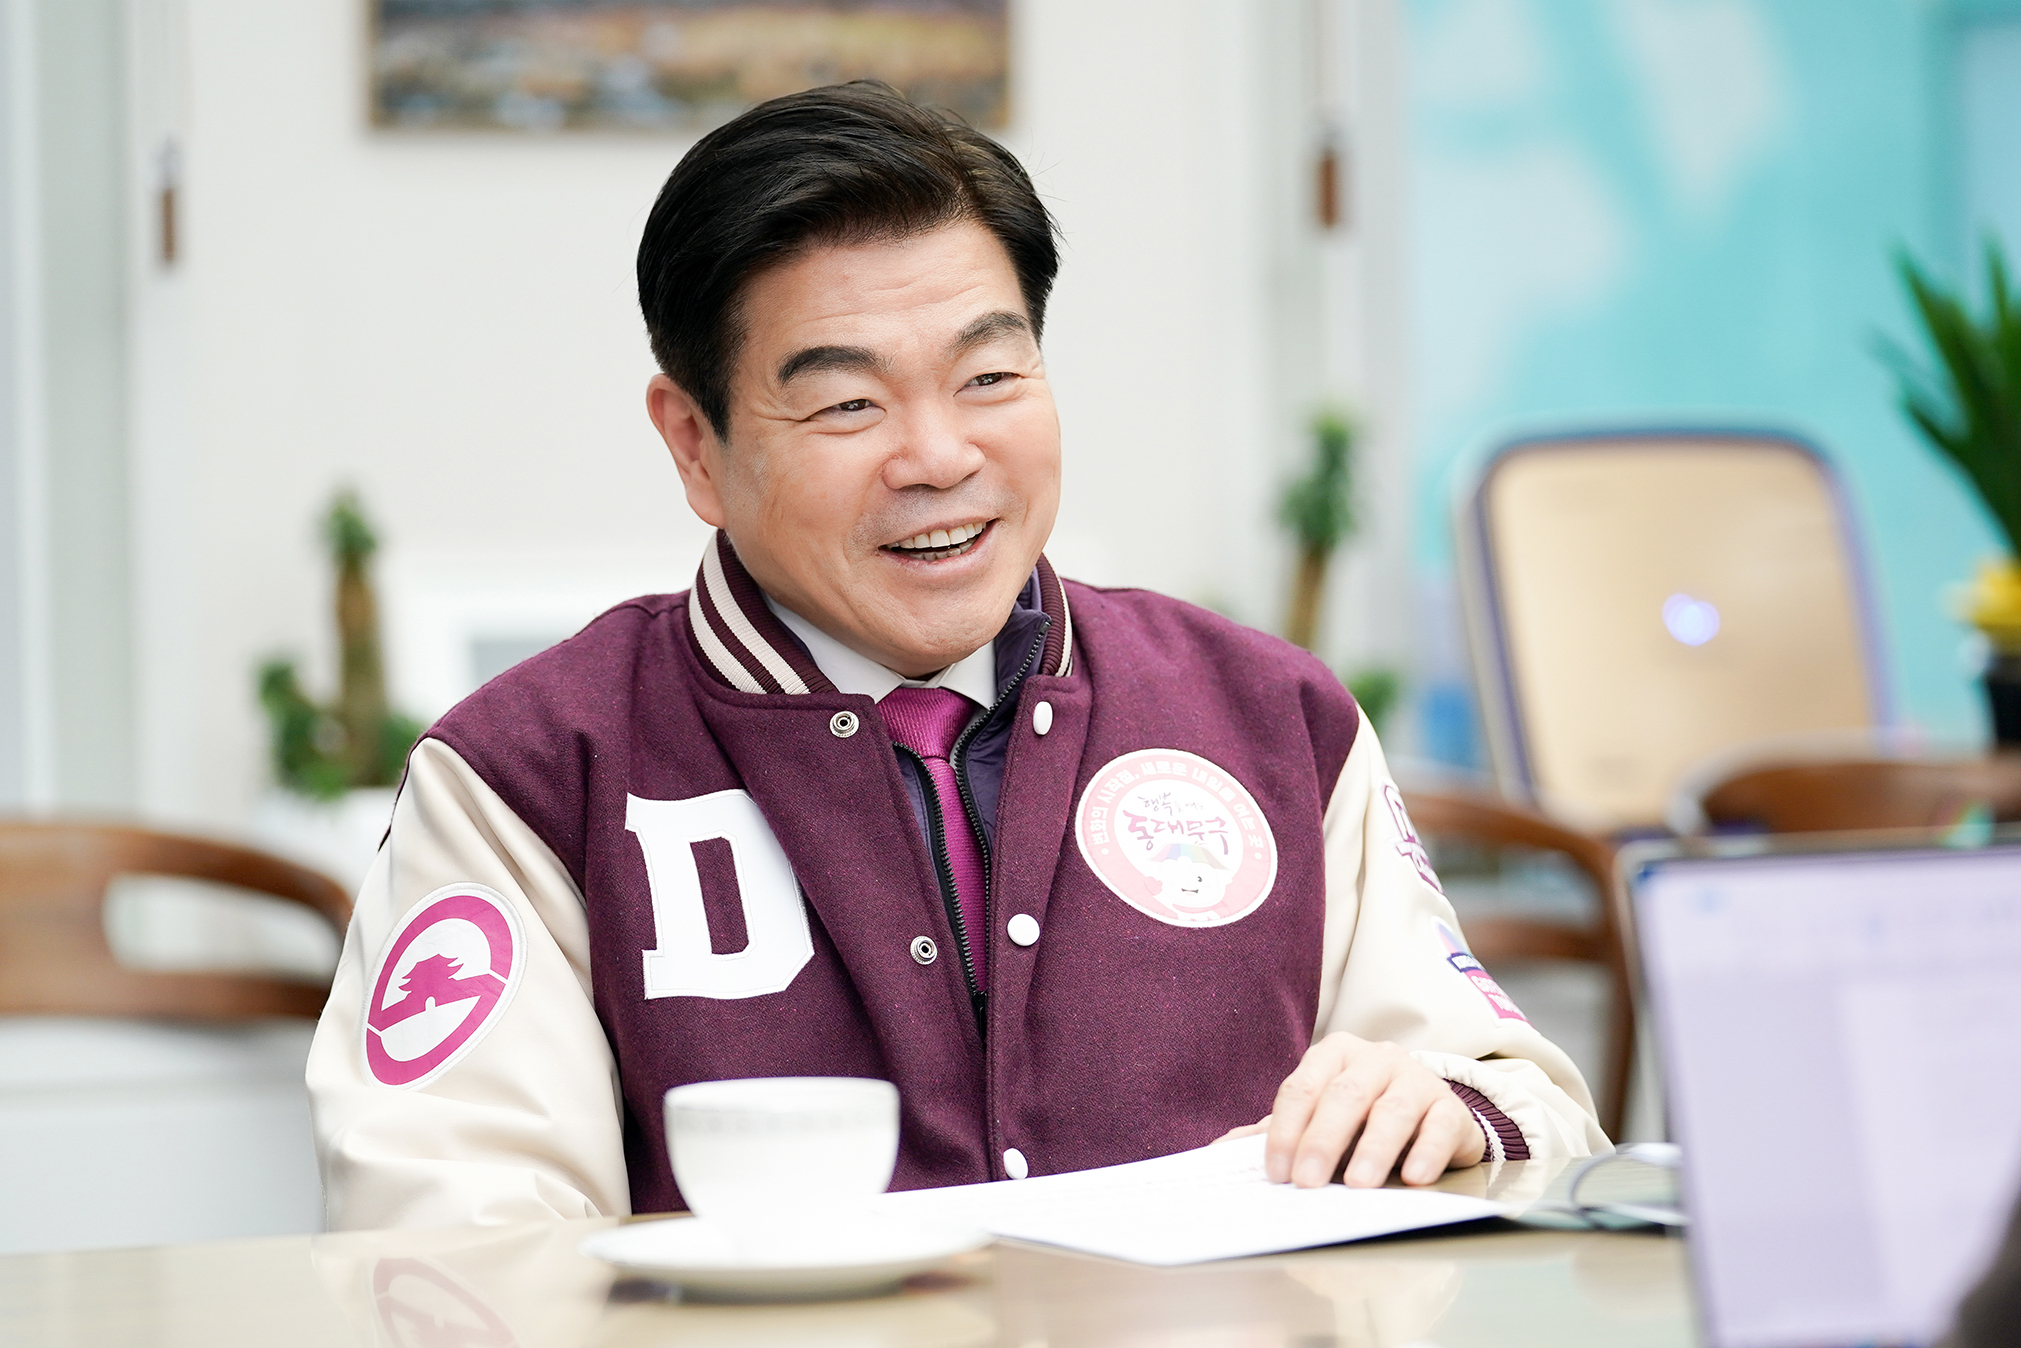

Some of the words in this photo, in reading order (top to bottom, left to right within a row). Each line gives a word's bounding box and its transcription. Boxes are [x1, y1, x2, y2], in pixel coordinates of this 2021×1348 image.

[1090, 807, 1109, 845] 변화의
[1140, 761, 1187, 777] 새로운
[1192, 768, 1236, 802] 내일을
[1233, 804, 1256, 830] 여는
[1247, 834, 1264, 848] 곳
[1122, 809, 1229, 855] 동대문구
[625, 788, 815, 1000] D
